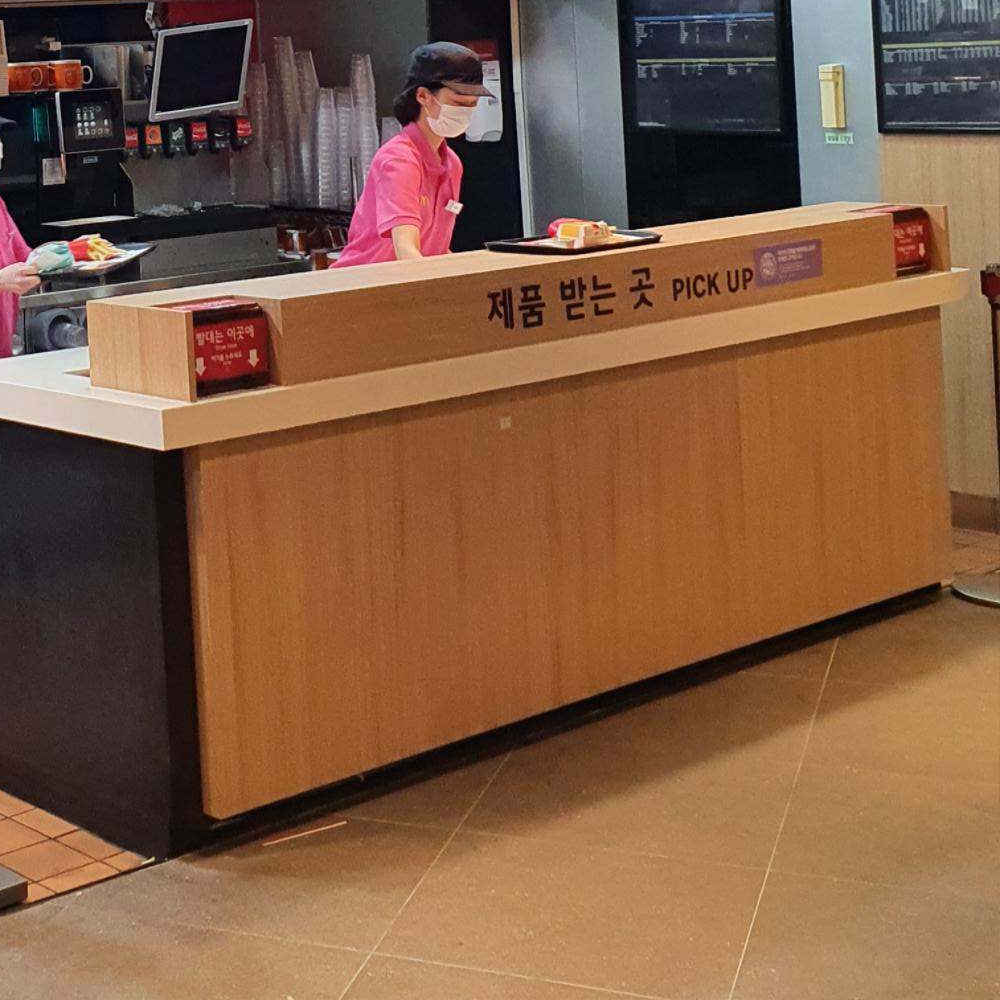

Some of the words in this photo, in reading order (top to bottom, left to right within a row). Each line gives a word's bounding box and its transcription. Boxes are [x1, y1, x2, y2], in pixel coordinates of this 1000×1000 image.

[486, 284, 546, 330] 제품
[559, 276, 617, 321] 받는
[629, 266, 655, 311] 곳
[672, 272, 720, 302] PICK
[726, 266, 754, 293] UP
[226, 323, 255, 341] 이곳에
